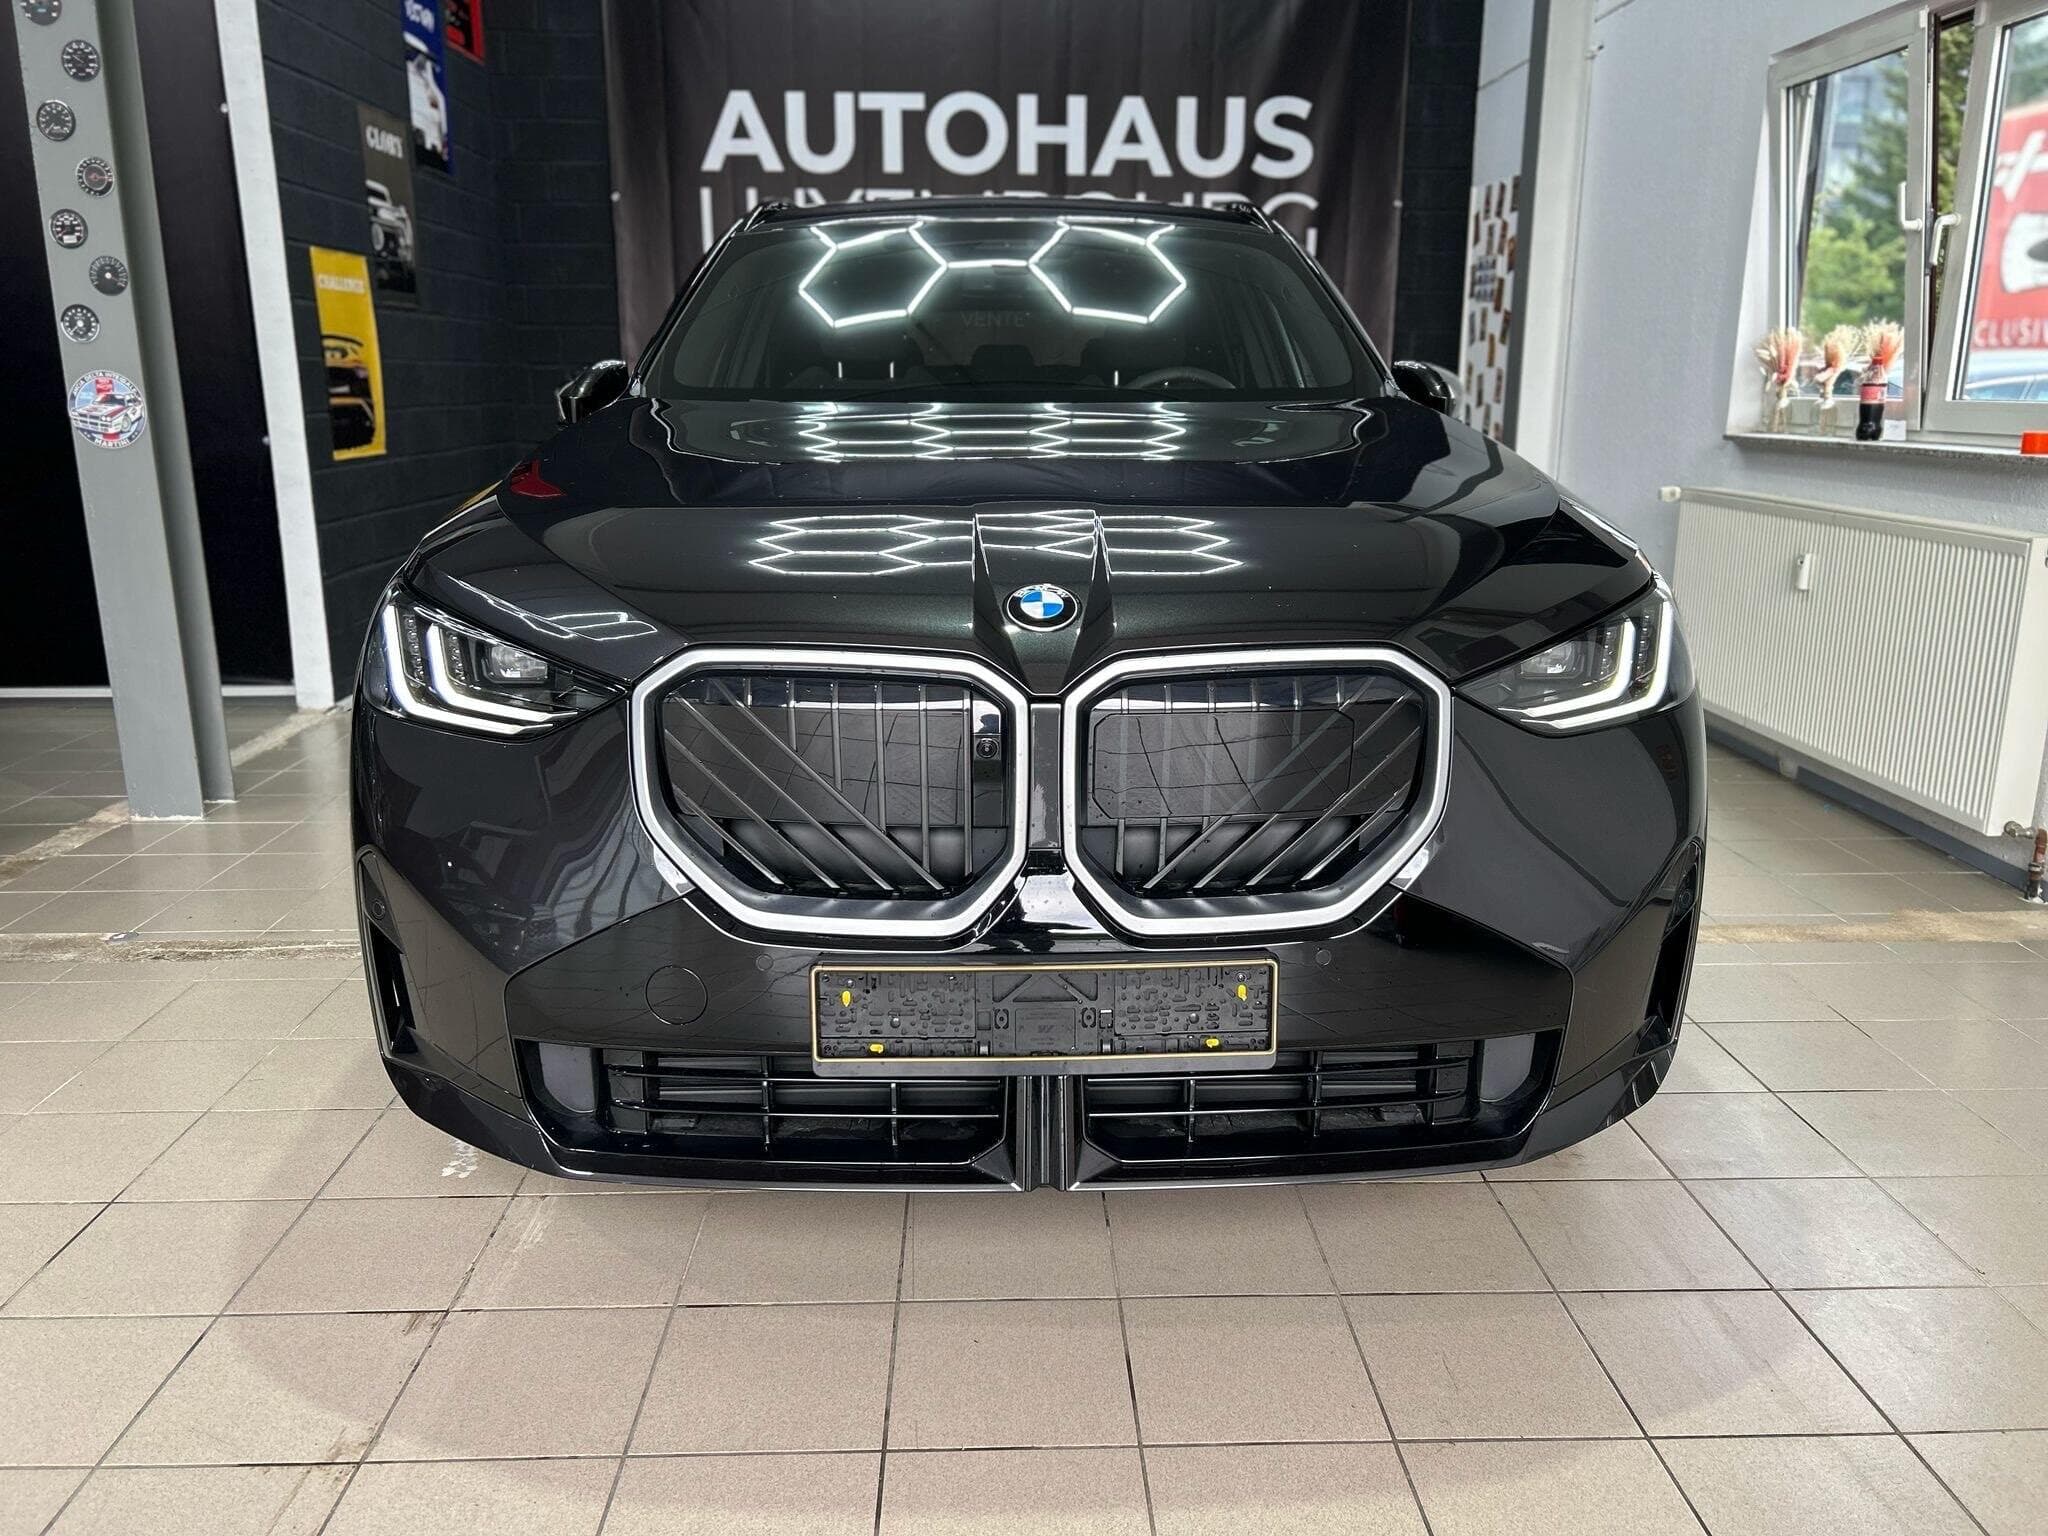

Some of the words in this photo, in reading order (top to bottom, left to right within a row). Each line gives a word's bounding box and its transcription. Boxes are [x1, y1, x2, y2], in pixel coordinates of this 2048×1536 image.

[701, 90, 1314, 179] AUTOHAUS
[961, 311, 1024, 328] VENTE
[94, 439, 130, 448] MARTINI
